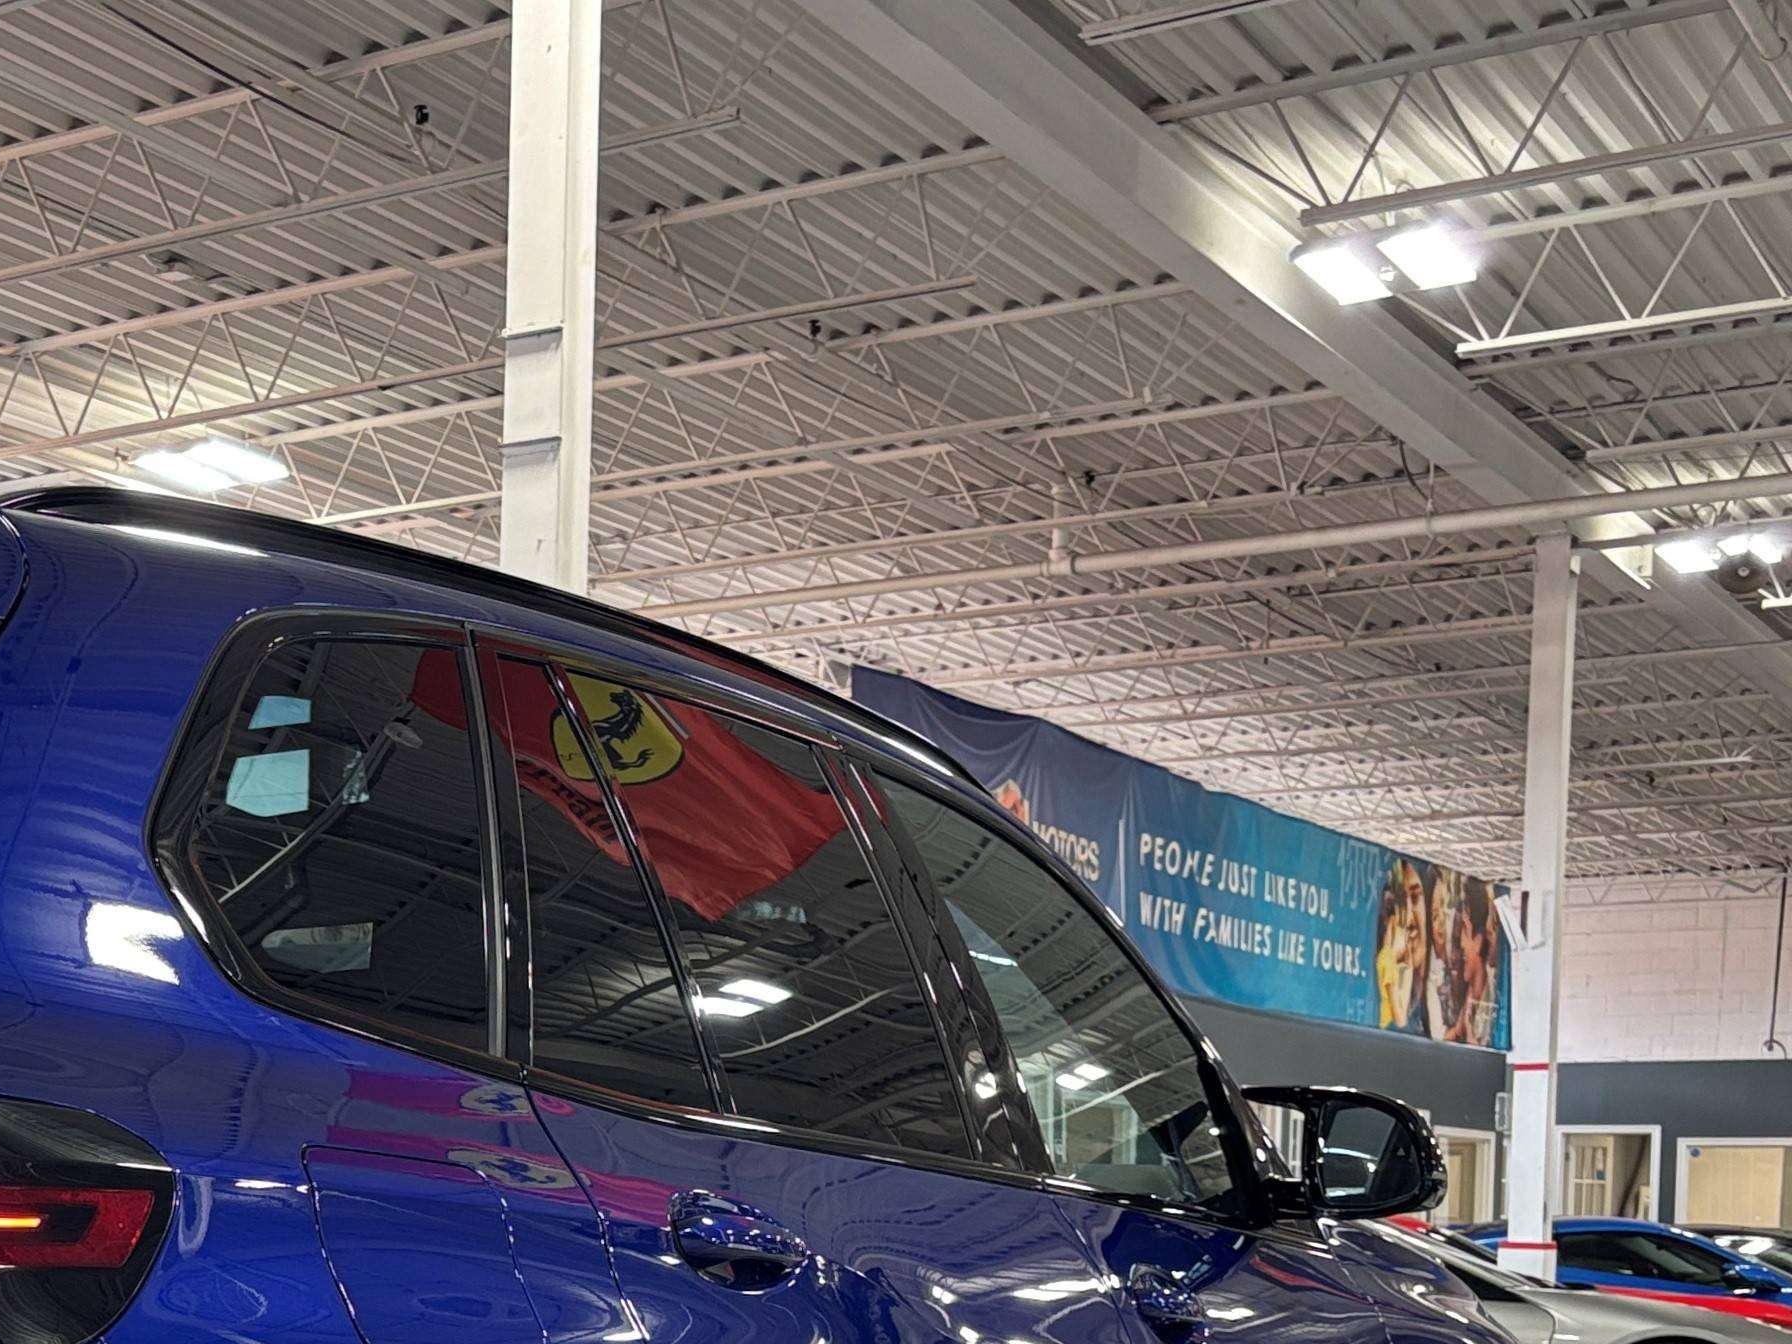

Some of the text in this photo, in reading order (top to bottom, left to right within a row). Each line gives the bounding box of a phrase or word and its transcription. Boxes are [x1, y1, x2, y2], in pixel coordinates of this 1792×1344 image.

[1218, 859, 1258, 898] JUST
[1139, 891, 1367, 977] WITH FAMILIES LIKE YOURS.
